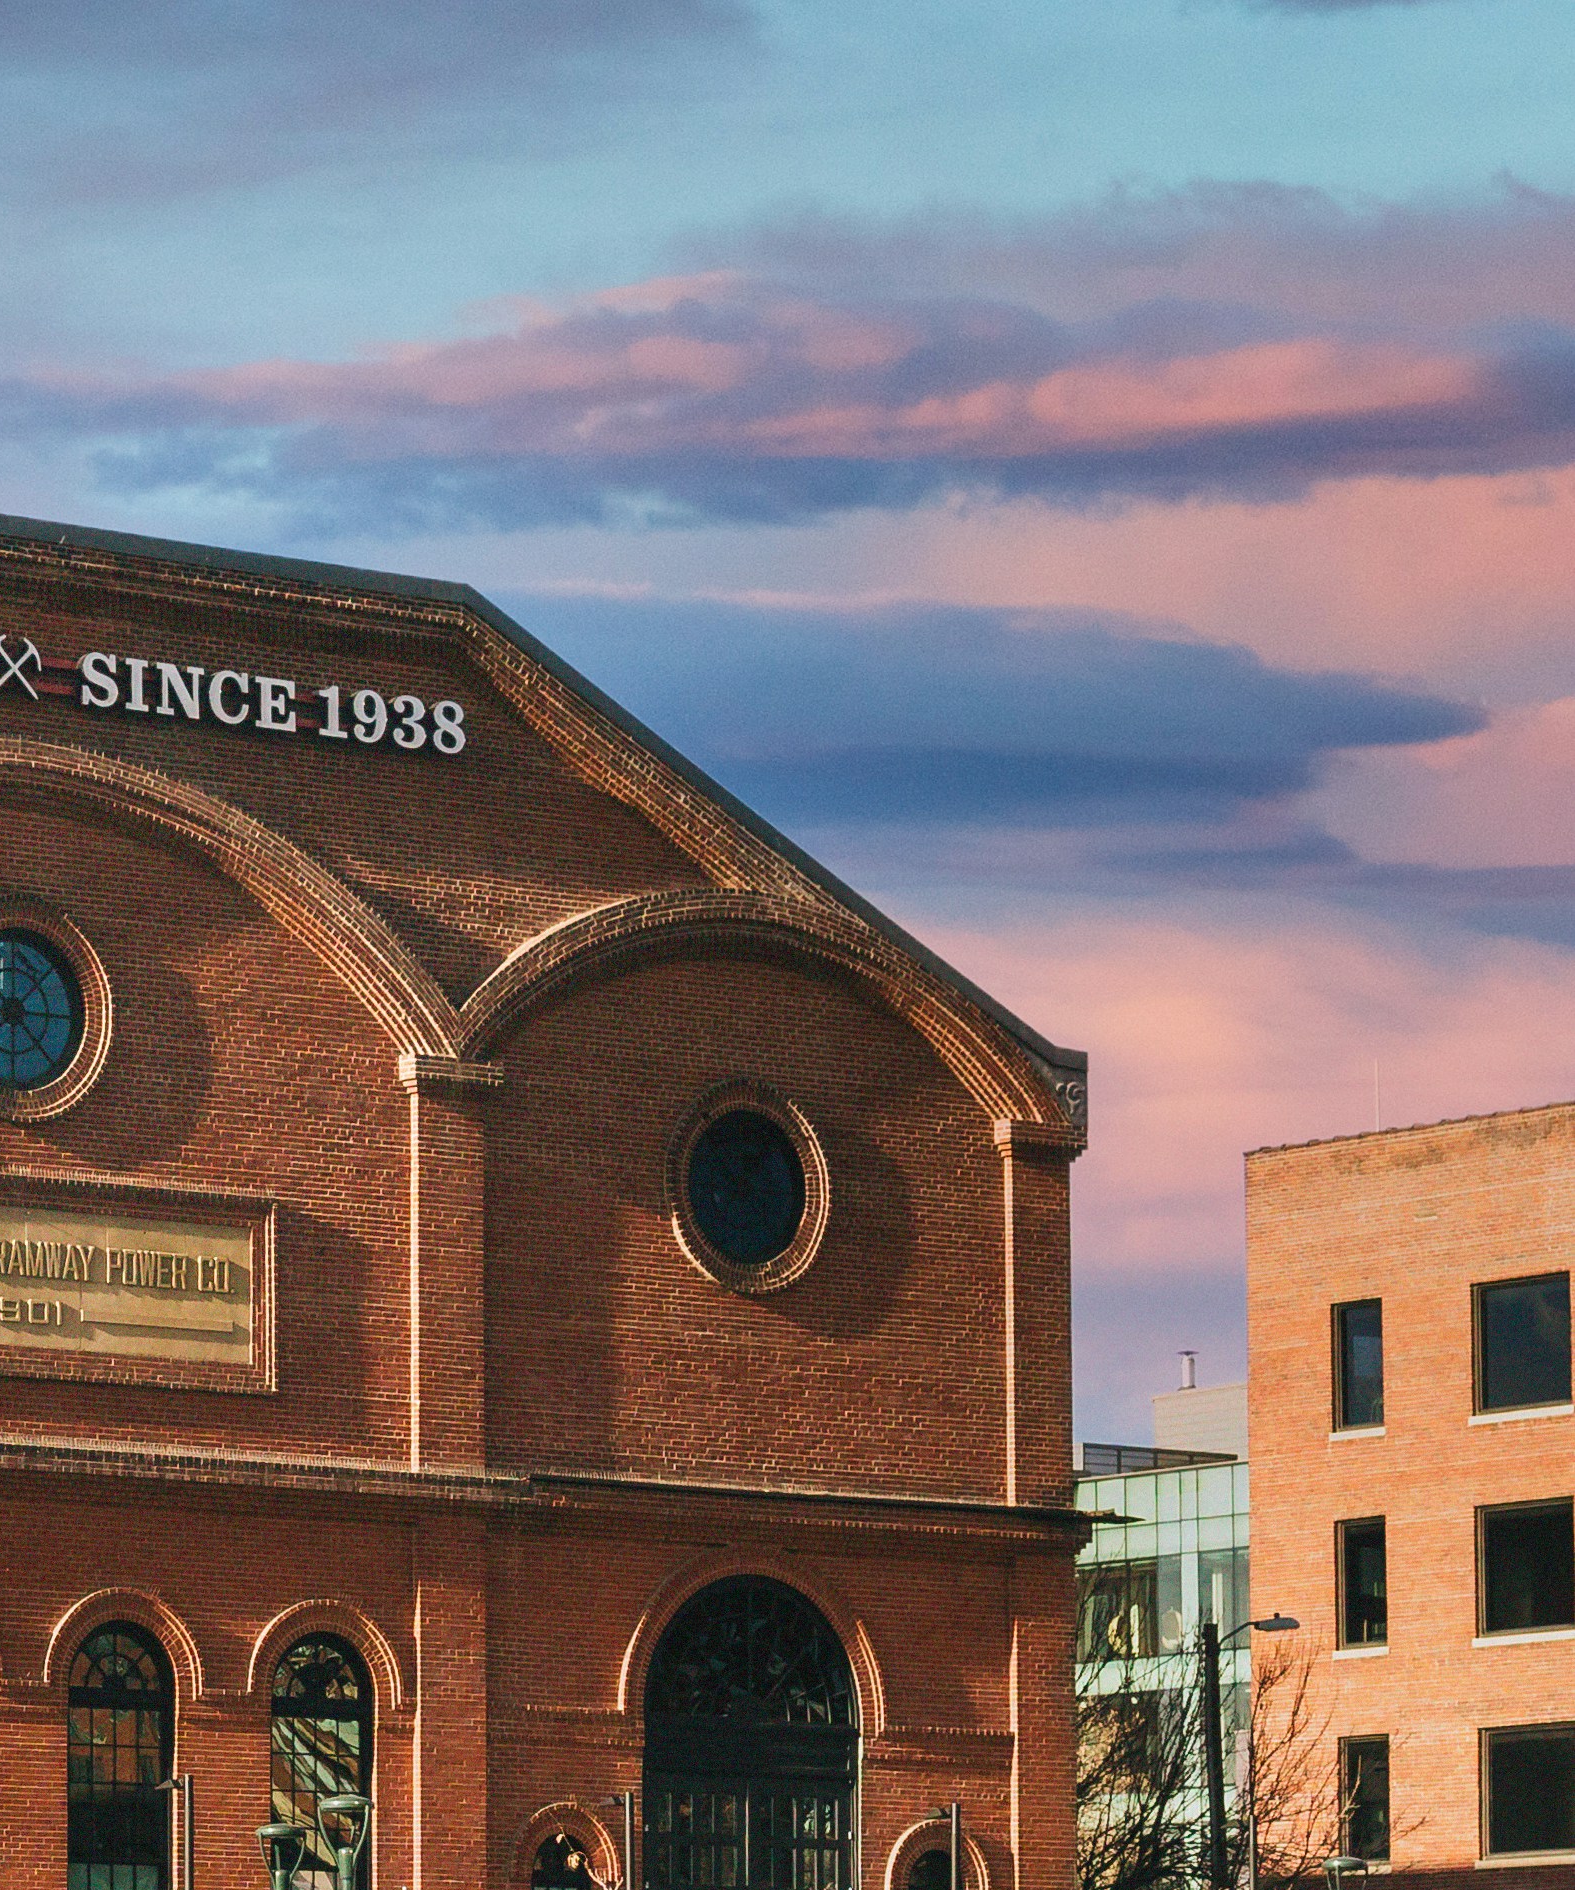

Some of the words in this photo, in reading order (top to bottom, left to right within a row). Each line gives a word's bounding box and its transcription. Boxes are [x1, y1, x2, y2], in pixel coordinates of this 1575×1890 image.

[79, 651, 297, 732] SINCE
[317, 685, 467, 754] 1938
[106, 1247, 189, 1290] POWER
[197, 1255, 235, 1294] CO.
